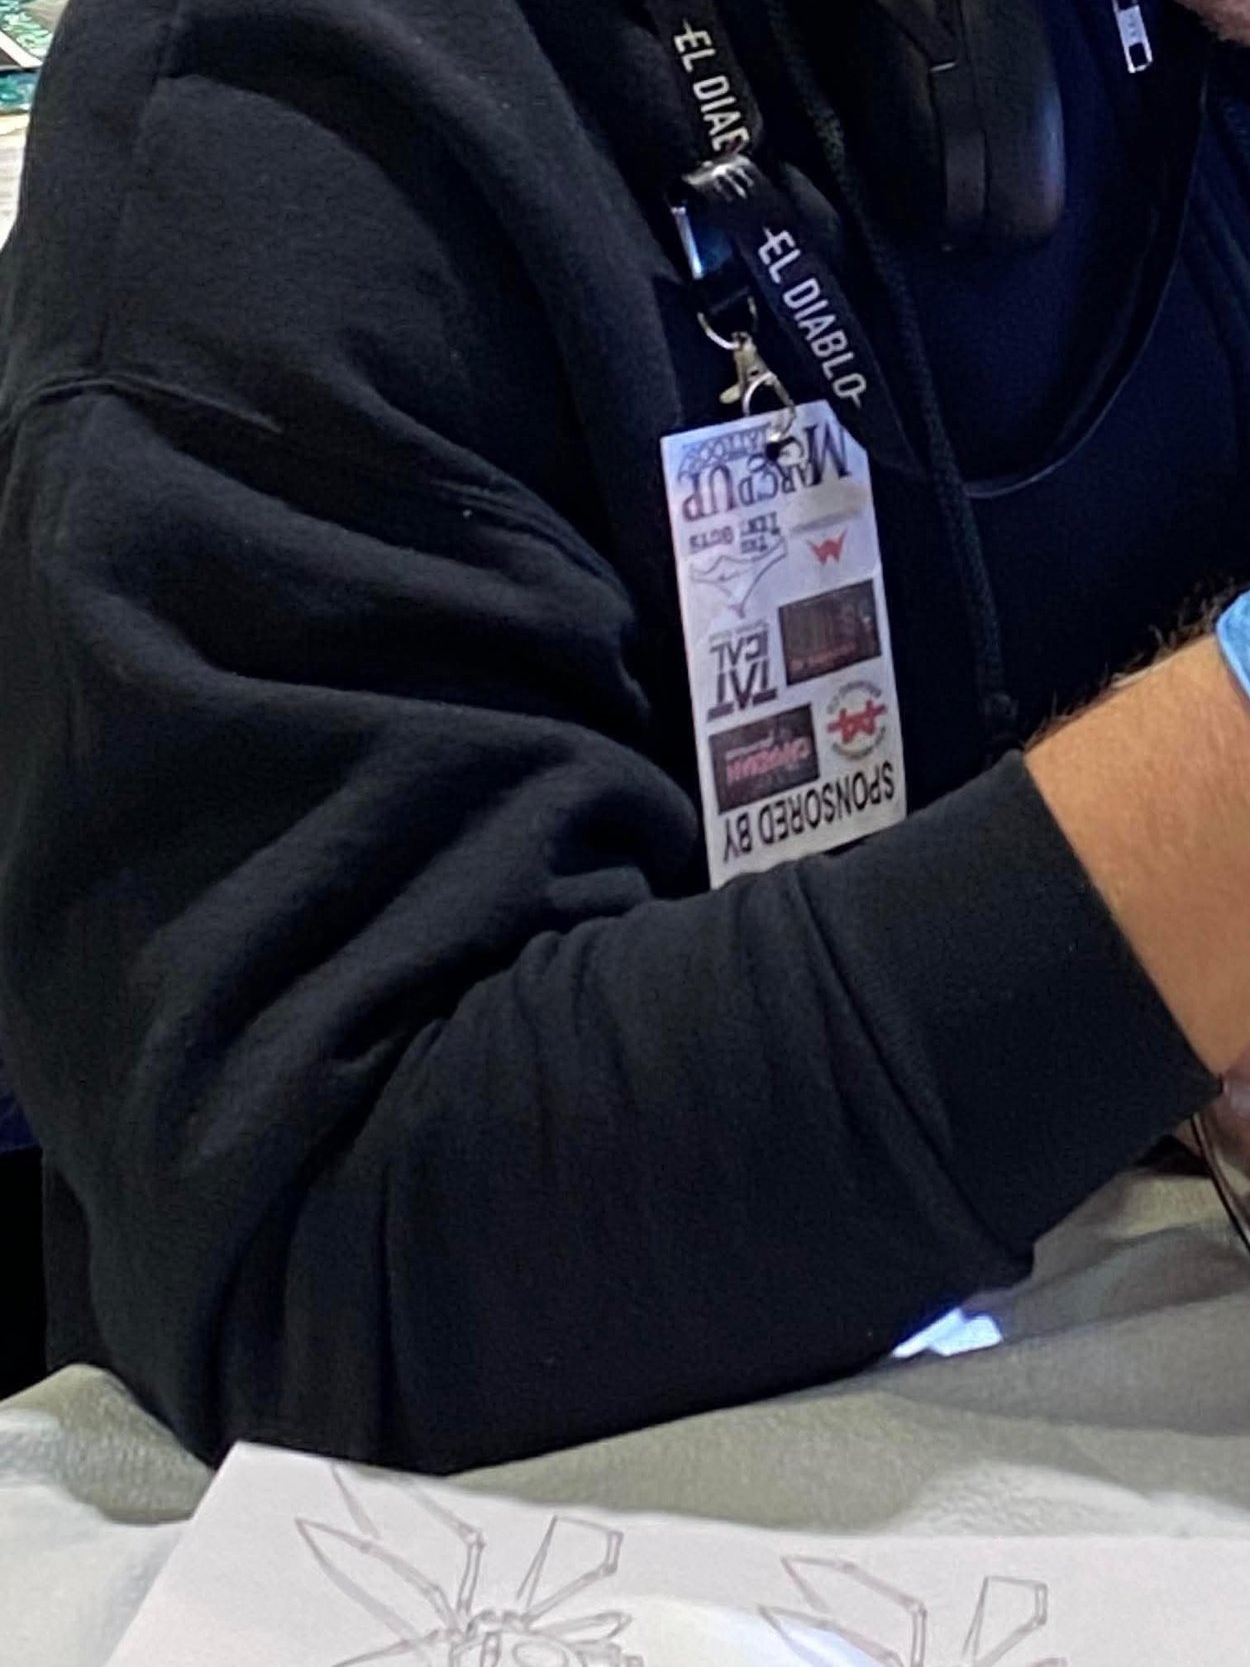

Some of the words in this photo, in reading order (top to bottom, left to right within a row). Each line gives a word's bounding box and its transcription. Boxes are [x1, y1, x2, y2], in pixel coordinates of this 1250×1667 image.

[673, 22, 715, 72] EL
[758, 227, 801, 284] EL
[783, 277, 867, 406] DIABLO
[707, 659, 778, 723] TAT
[758, 760, 896, 845] SPONSORED
[723, 812, 753, 863] BY
